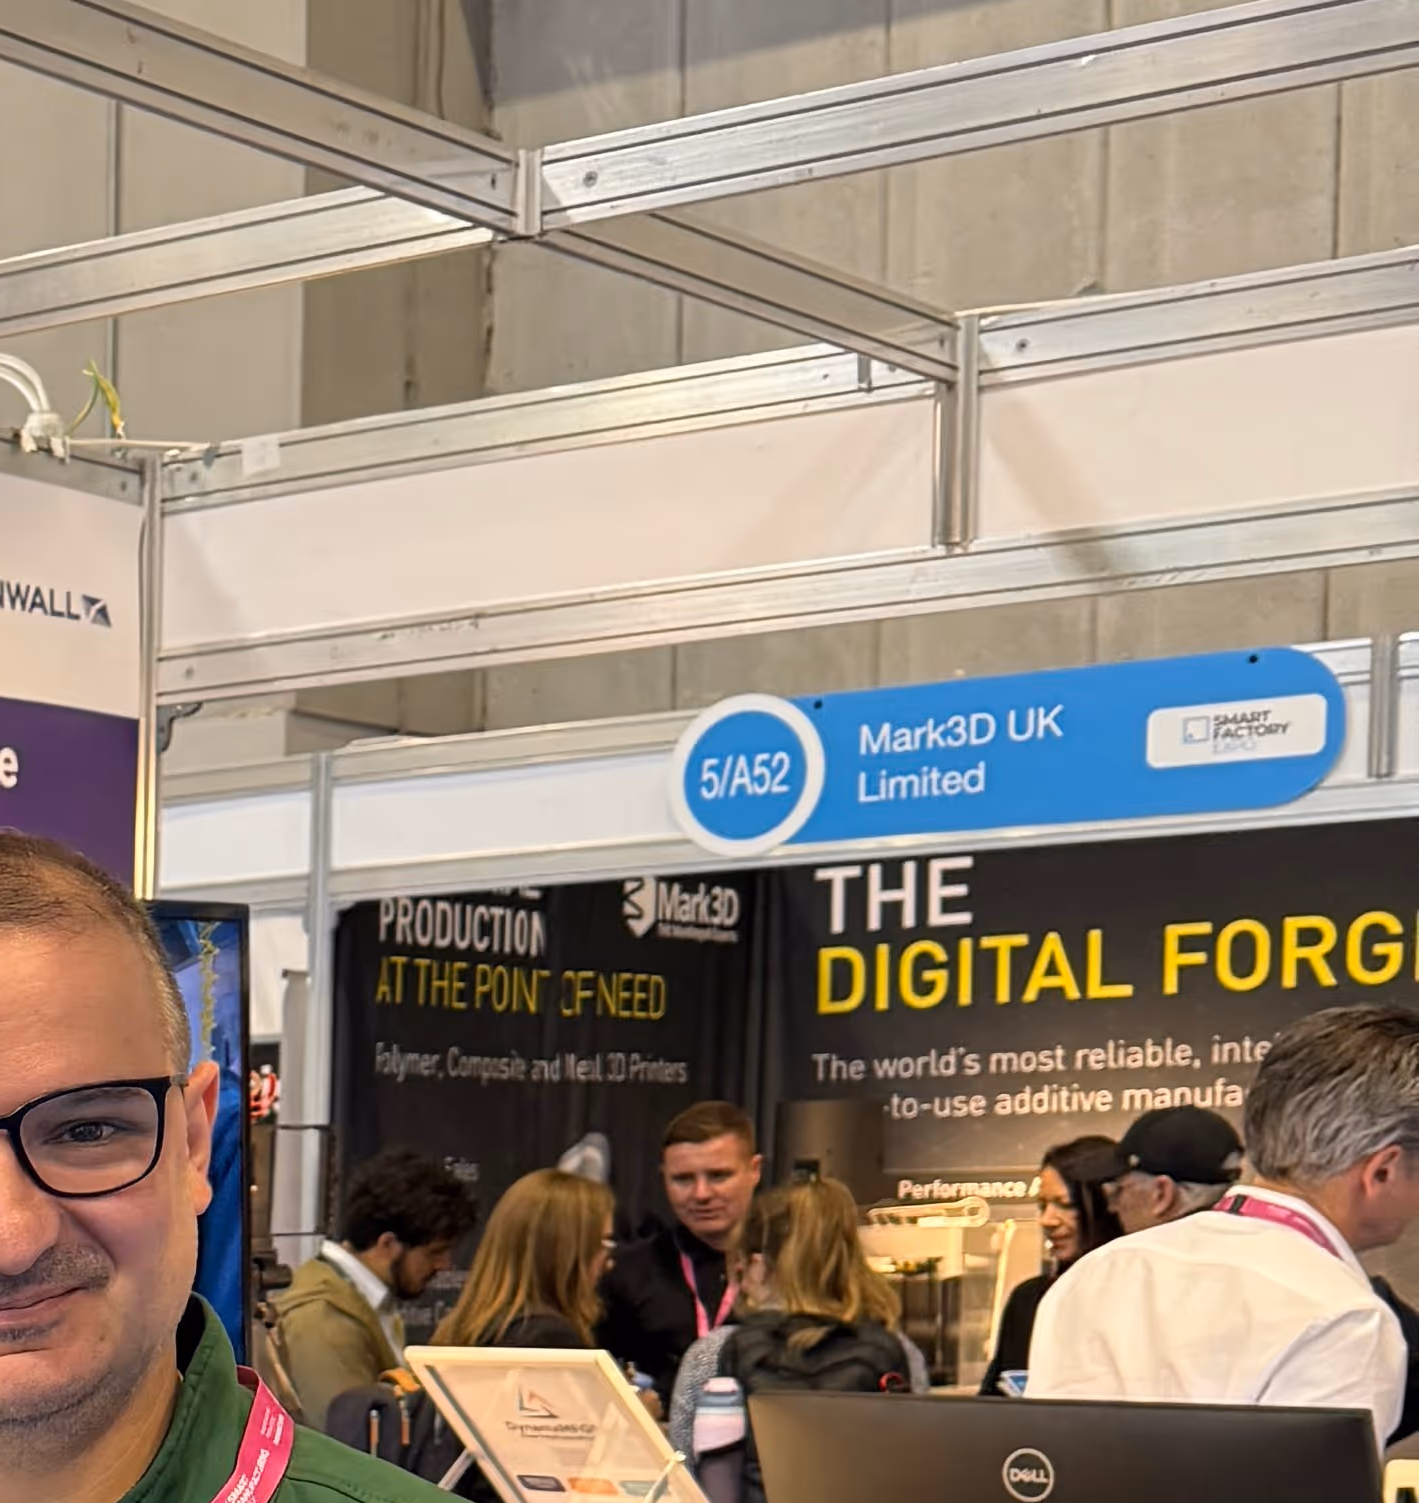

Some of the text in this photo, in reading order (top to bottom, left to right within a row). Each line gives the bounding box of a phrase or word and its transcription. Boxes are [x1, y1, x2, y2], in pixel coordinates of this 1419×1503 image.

[859, 705, 1065, 756] Mark3D UK
[1213, 710, 1271, 726] SMART
[1213, 721, 1290, 741] FACTORY
[699, 751, 791, 801] 5/A52
[857, 762, 985, 803] Limited
[658, 881, 741, 927] Mark3D
[814, 857, 974, 934] THE
[378, 897, 546, 957] PRODUCTION
[818, 911, 1419, 1015] DIGITAL FORG
[376, 956, 408, 1004] AT
[413, 958, 471, 1009] THE
[596, 971, 667, 1020] NEED
[811, 1054, 865, 1082] The
[989, 1043, 1066, 1076] most
[1074, 1036, 1202, 1072] reliable,
[995, 1083, 1113, 1117] additive
[898, 1178, 1027, 1201] Performance
[1009, 1467, 1050, 1483] DELL
